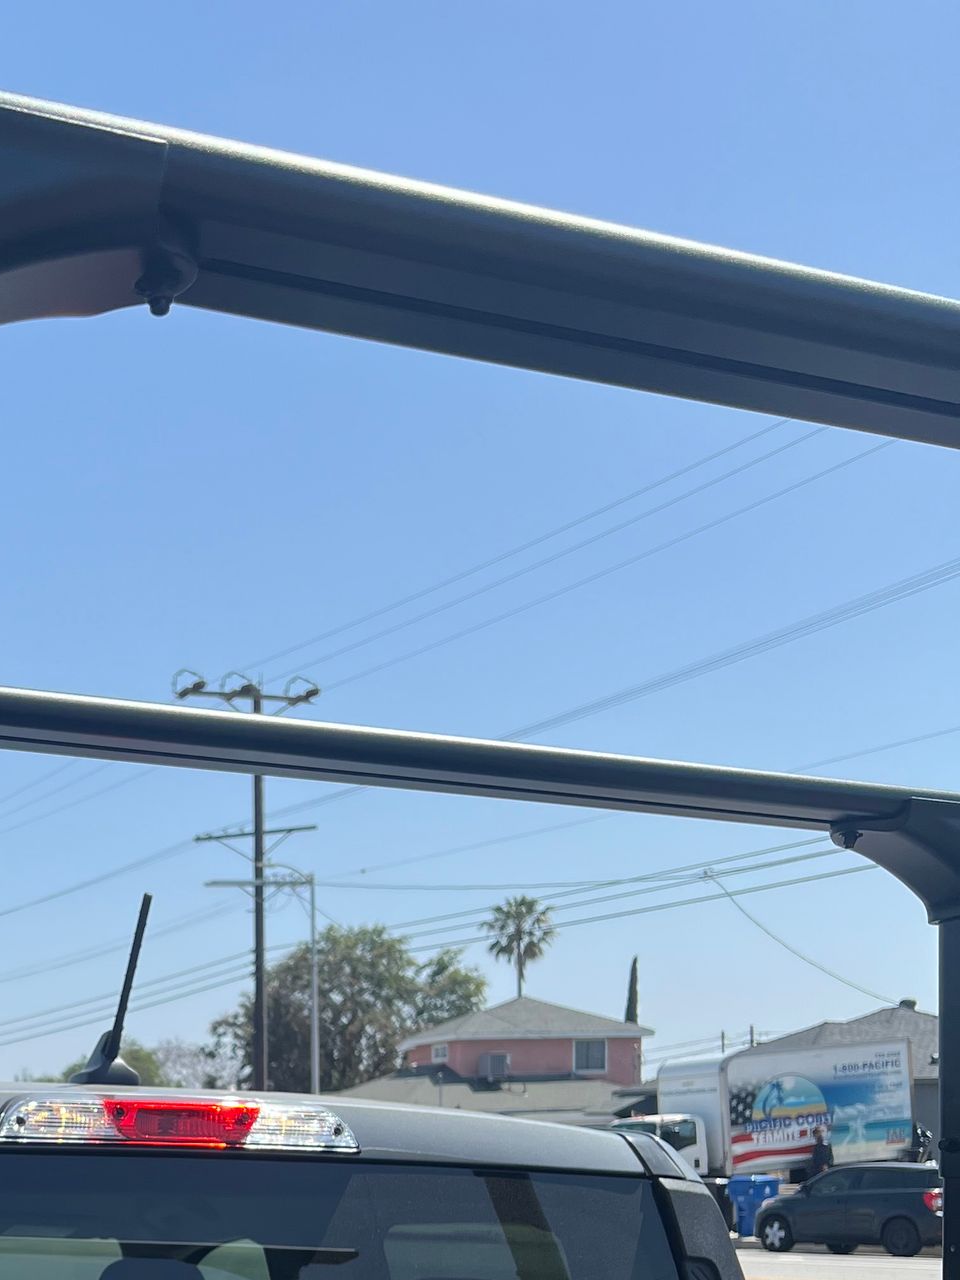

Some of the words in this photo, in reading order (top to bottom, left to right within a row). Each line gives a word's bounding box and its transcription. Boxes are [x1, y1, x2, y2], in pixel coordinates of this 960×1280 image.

[745, 1116, 791, 1133] PACIFIC
[796, 1111, 833, 1127] COAST
[752, 1126, 799, 1144] TERMITE
